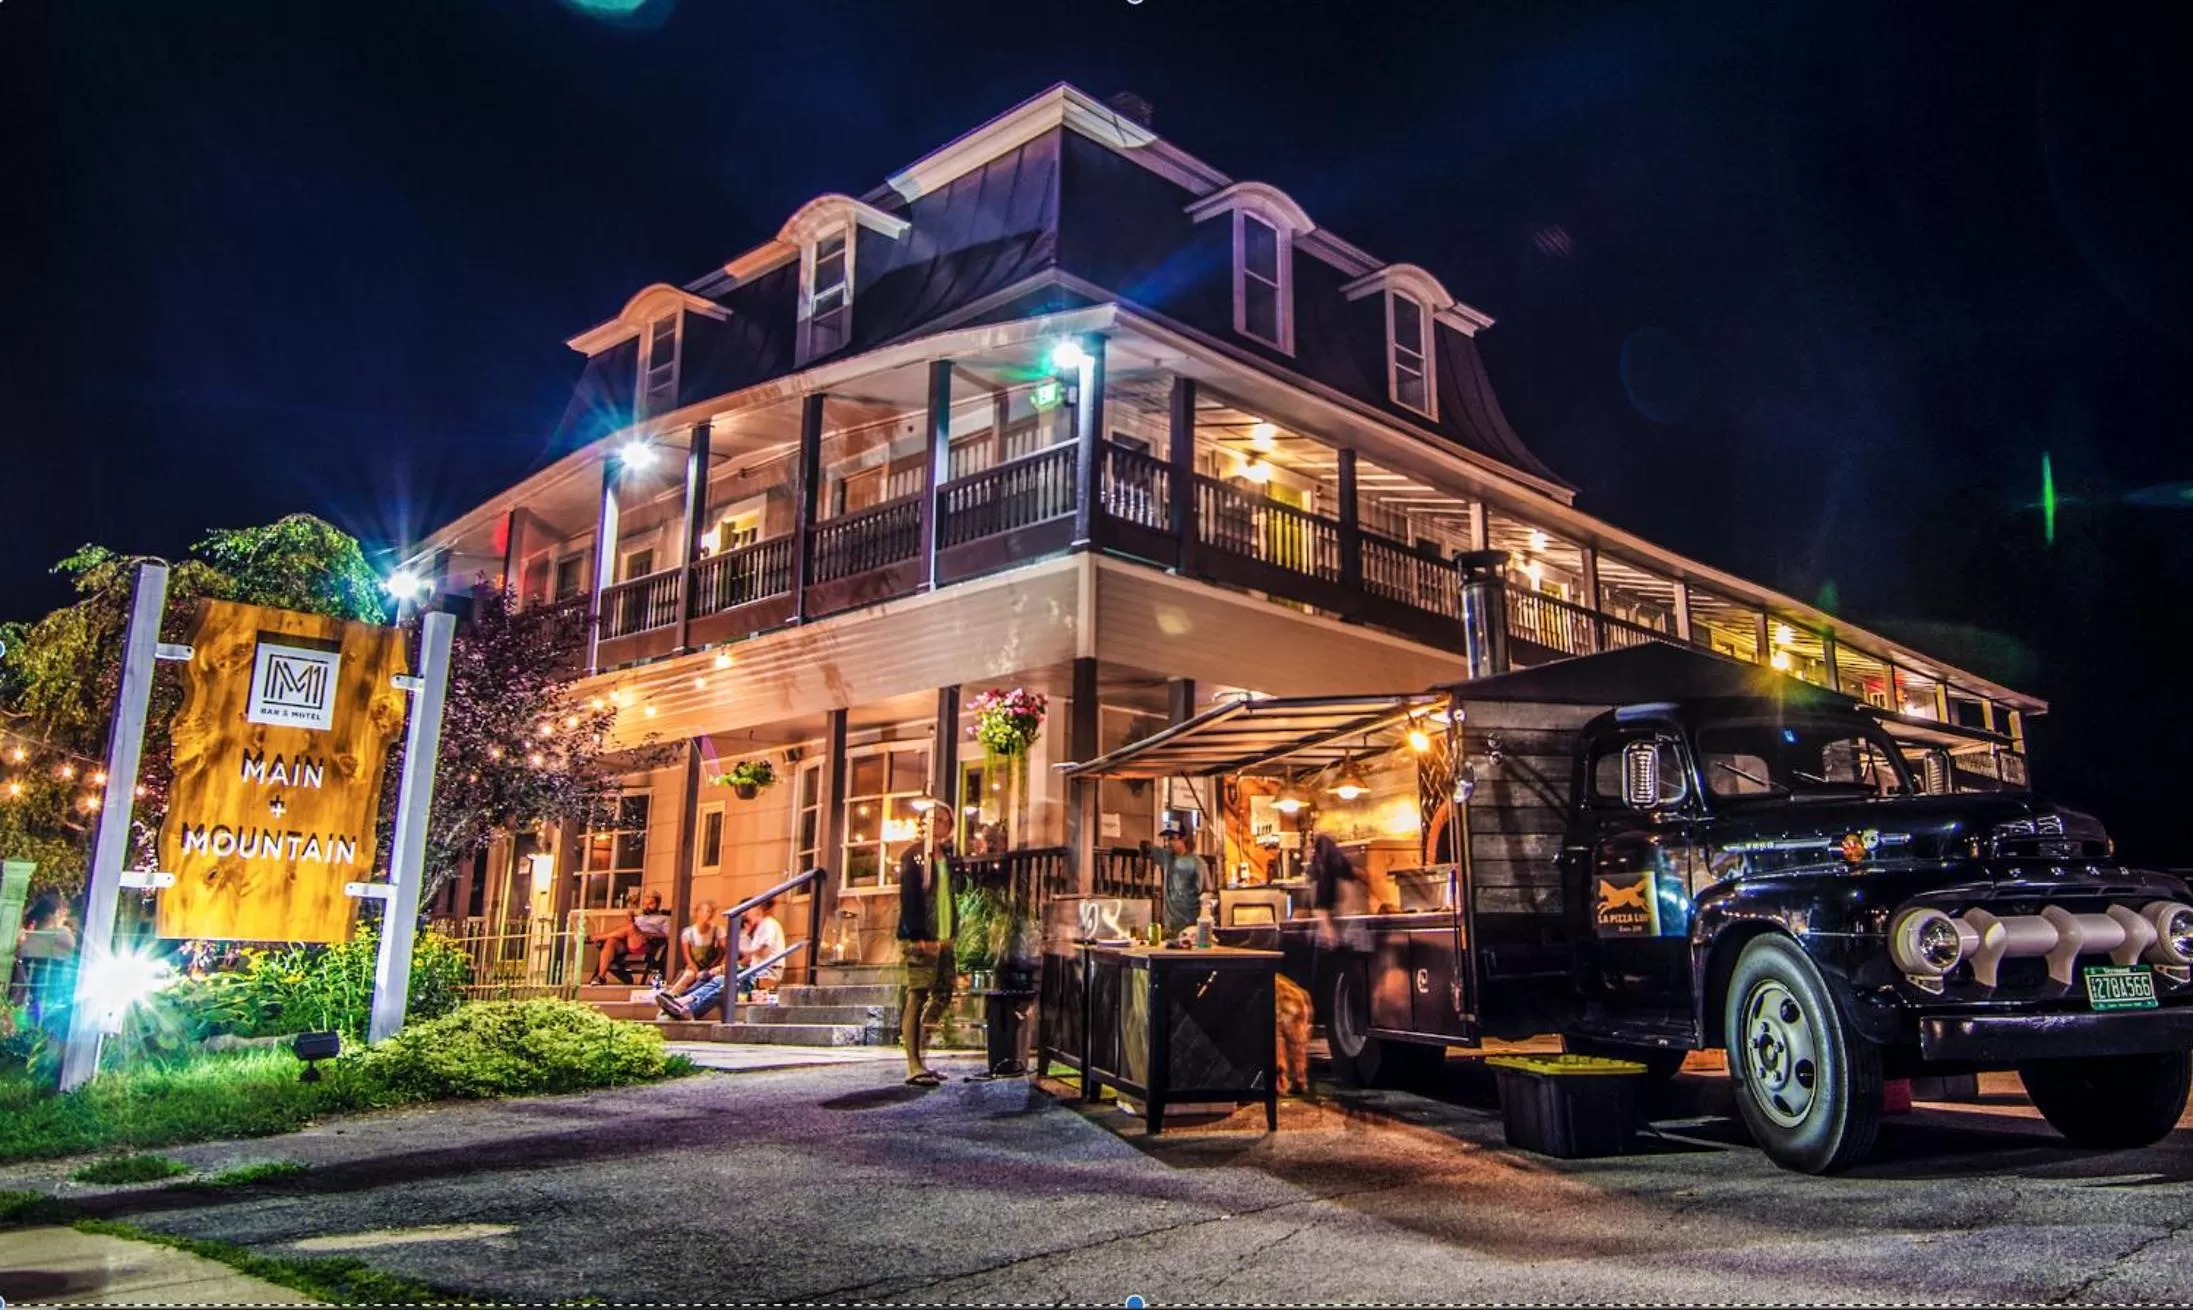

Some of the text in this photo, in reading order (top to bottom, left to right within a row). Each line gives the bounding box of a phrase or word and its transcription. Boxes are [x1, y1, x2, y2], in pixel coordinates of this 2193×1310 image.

[260, 707, 280, 715] BAR
[292, 711, 321, 721] MOTEL
[241, 758, 324, 789] MAIN
[270, 802, 287, 818] +
[182, 829, 357, 864] MOUNTAIN
[1598, 914, 1609, 924] LA
[1609, 913, 1633, 924] PIZZA
[2095, 976, 2151, 1000] 278A566
